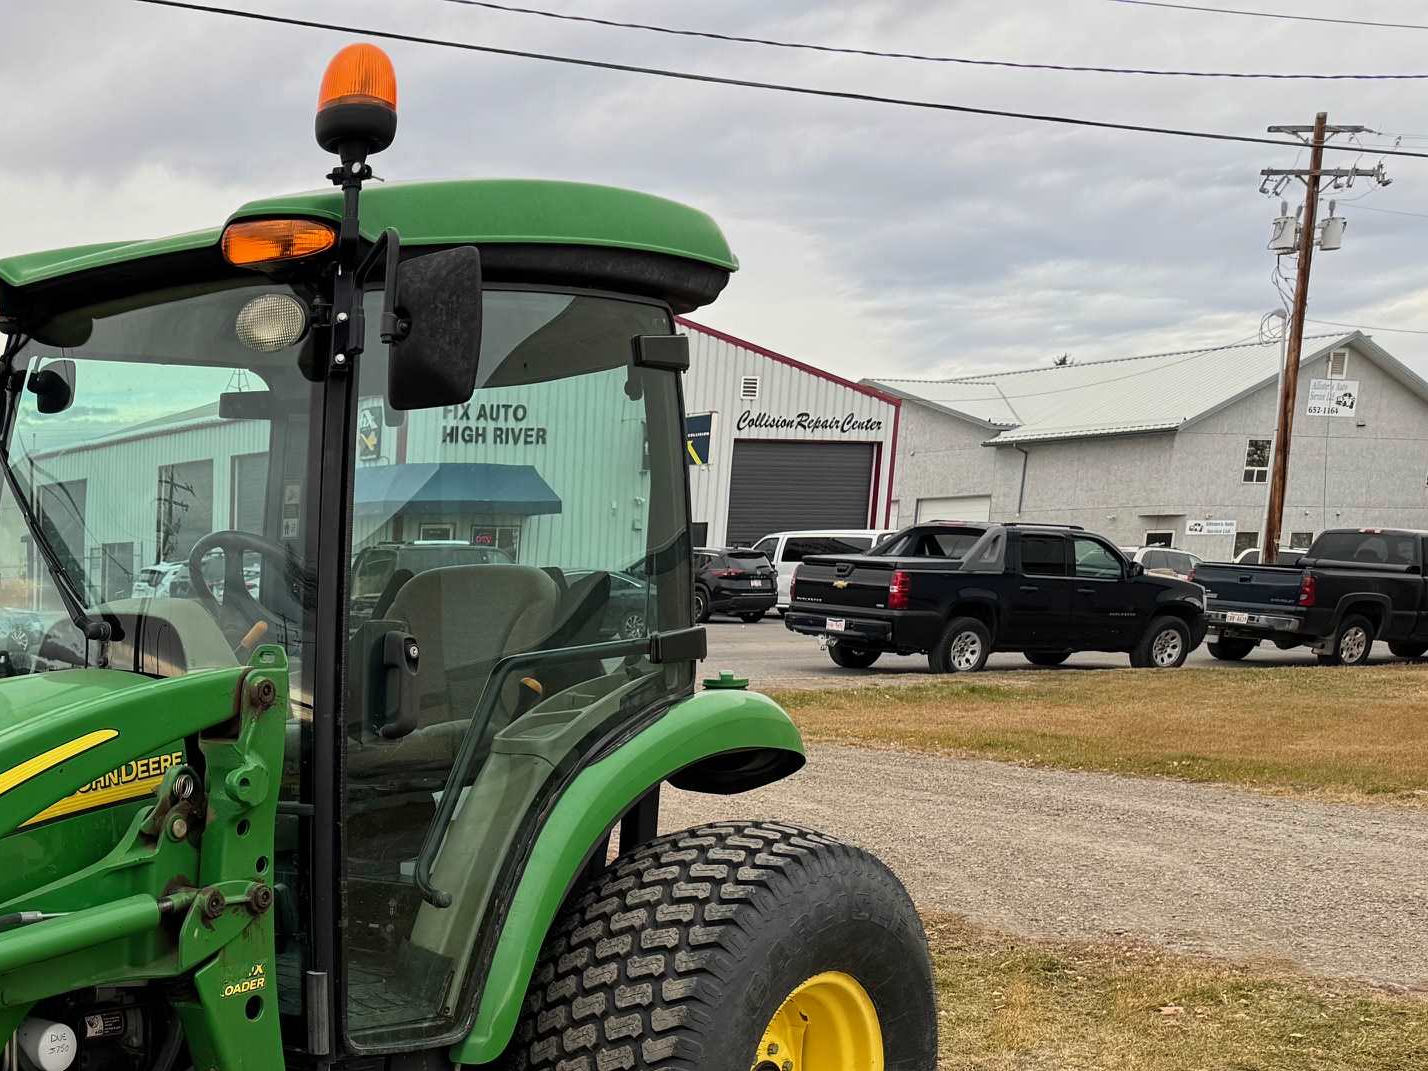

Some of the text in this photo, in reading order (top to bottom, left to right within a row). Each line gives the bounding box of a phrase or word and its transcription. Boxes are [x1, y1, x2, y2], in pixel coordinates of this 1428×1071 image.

[442, 403, 527, 422] FIX AUTO
[736, 409, 883, 433] Collision Repair Center
[442, 425, 547, 445] HIGH RIVER
[219, 977, 265, 996] OADER
[50, 1032, 67, 1043] DUE
